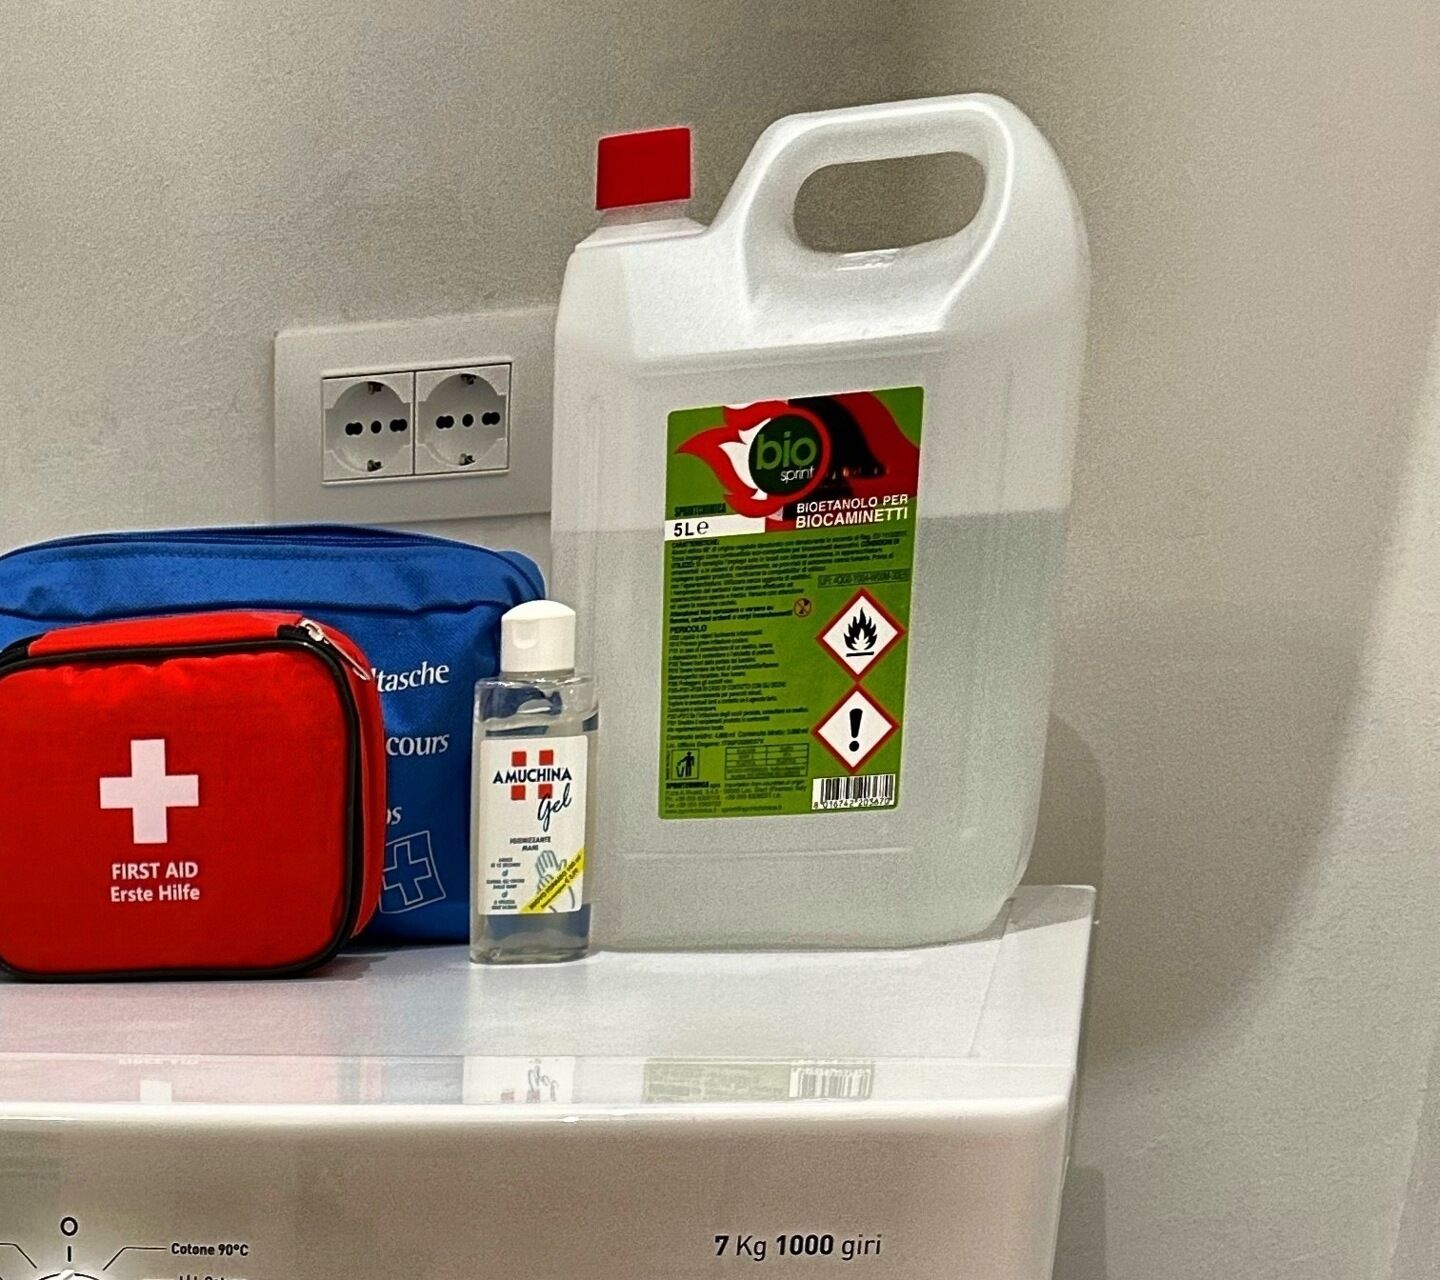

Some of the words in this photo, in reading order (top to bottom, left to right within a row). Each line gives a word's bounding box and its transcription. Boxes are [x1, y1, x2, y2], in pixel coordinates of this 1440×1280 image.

[756, 431, 817, 471] bio
[780, 466, 814, 484] sprint
[796, 496, 878, 514] BIOETANOLO
[883, 494, 909, 507] PER
[795, 507, 909, 529] BIOCAMINETTI
[386, 734, 450, 757] cours
[492, 767, 572, 784] AMUCHINA
[111, 862, 161, 880] FIRST
[165, 861, 199, 879] AID
[110, 886, 153, 902] Erste
[158, 883, 201, 901] Hilfe
[171, 1243, 215, 1256] Cotone
[218, 1244, 250, 1257] 90°C
[714, 1235, 729, 1257] 7
[736, 1235, 767, 1262] Kg
[776, 1234, 834, 1256] 1000
[841, 1233, 882, 1261] giri
